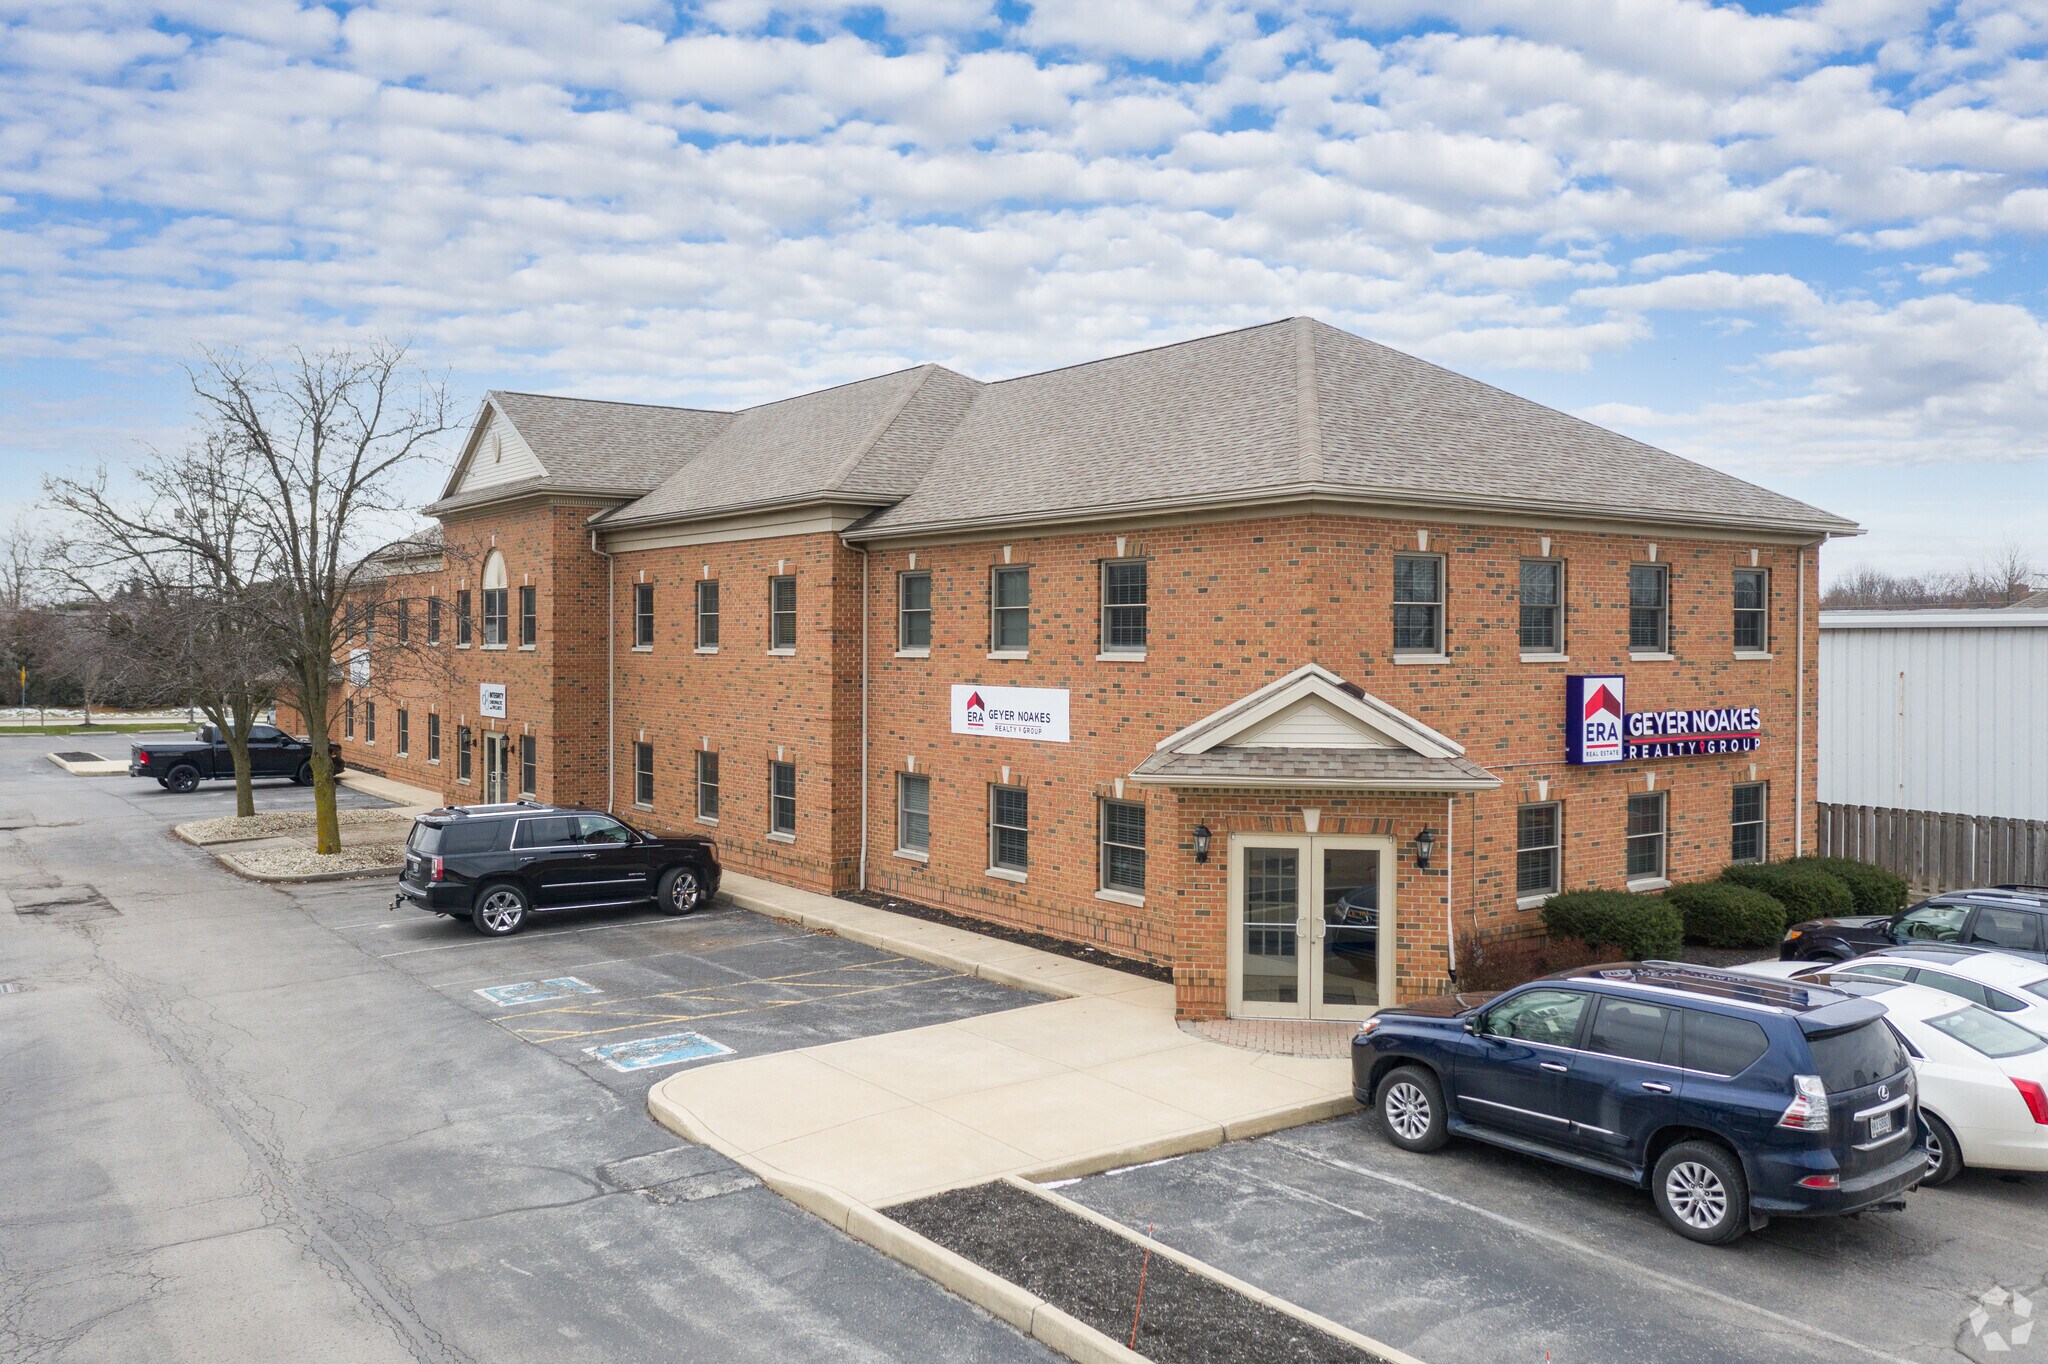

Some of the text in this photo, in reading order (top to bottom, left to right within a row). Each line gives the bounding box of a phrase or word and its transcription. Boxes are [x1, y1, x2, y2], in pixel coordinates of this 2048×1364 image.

[967, 711, 984, 723] ERA
[989, 710, 1051, 723] GEYER NOAKES
[1629, 708, 1760, 736] GEYER NOAKES
[995, 725, 1017, 733] REALTY
[1586, 722, 1619, 742] ERA
[1600, 749, 1619, 757] ESTATE
[1629, 738, 1761, 760] REALTY GROUP
